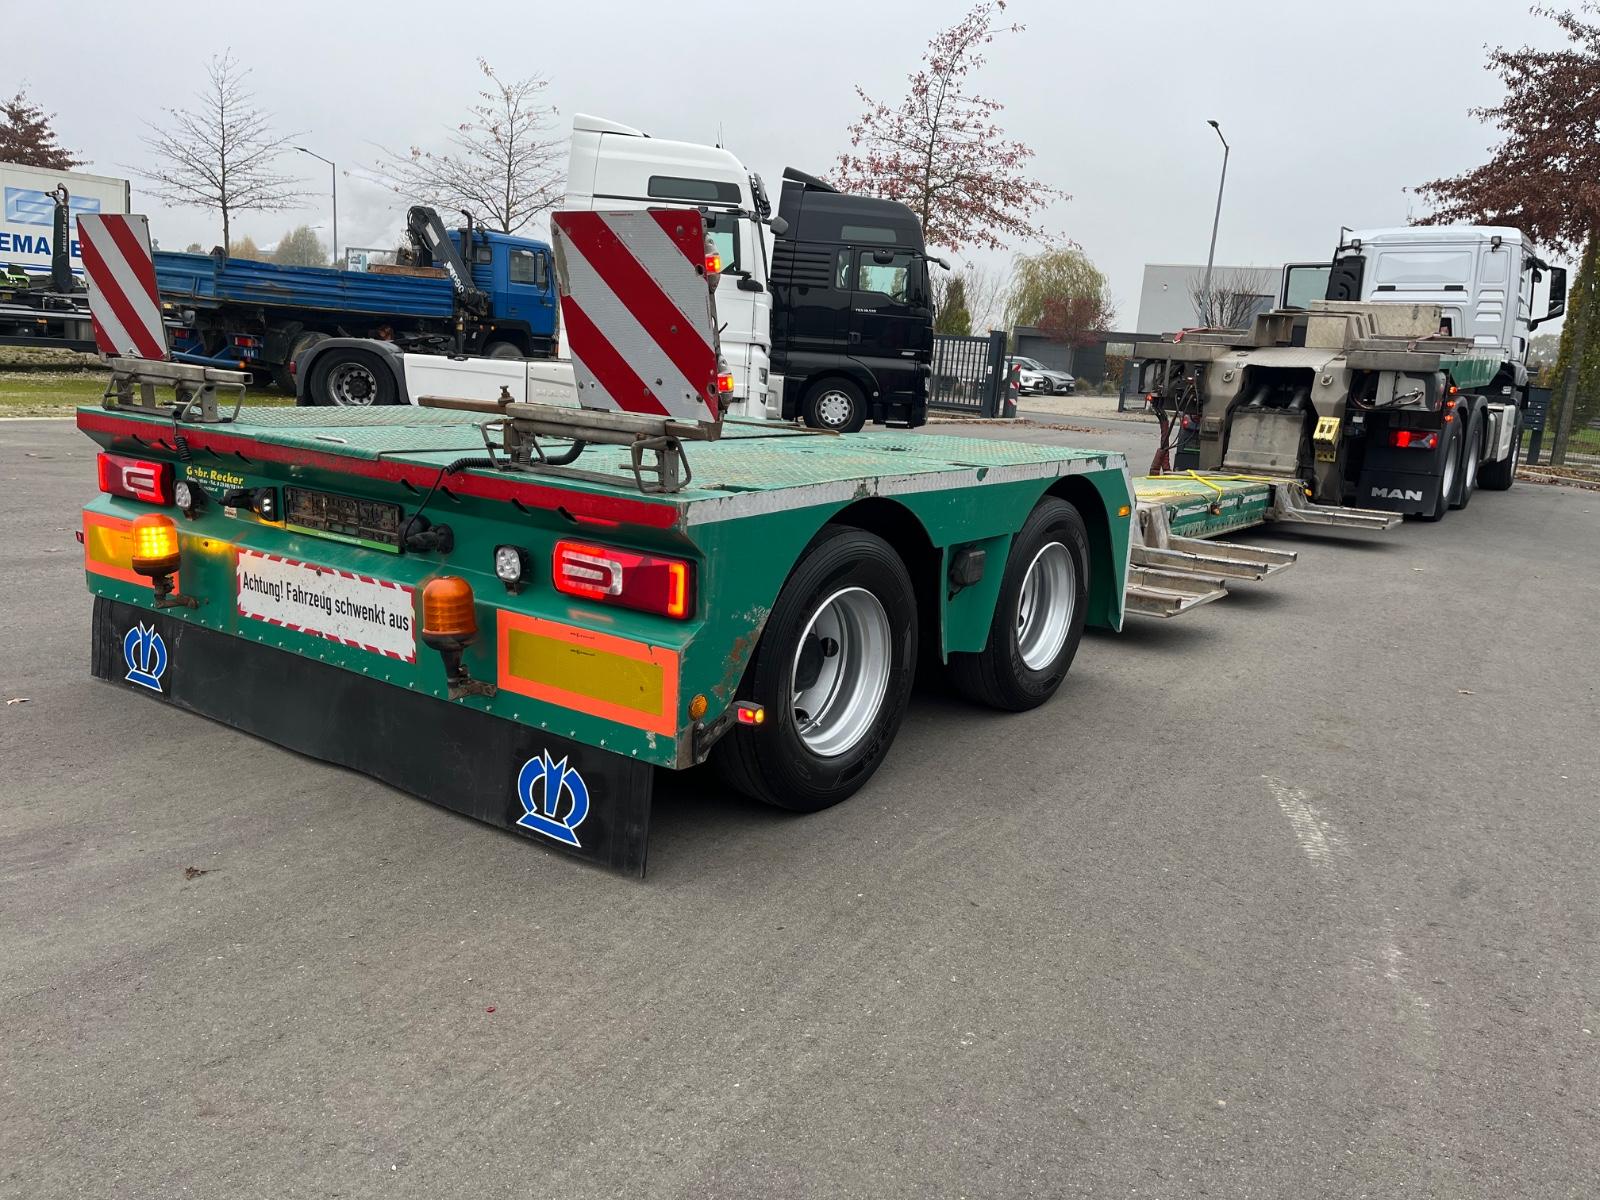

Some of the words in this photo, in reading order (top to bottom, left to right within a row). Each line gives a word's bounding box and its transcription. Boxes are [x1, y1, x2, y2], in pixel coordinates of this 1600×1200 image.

[0, 232, 81, 257] EMAE
[210, 470, 244, 485] Recker
[1371, 487, 1423, 501] MAN
[243, 571, 284, 603] Achtung!
[286, 581, 332, 616] Fahrzeug
[334, 596, 386, 626] schwenkt
[389, 612, 409, 631] aus
